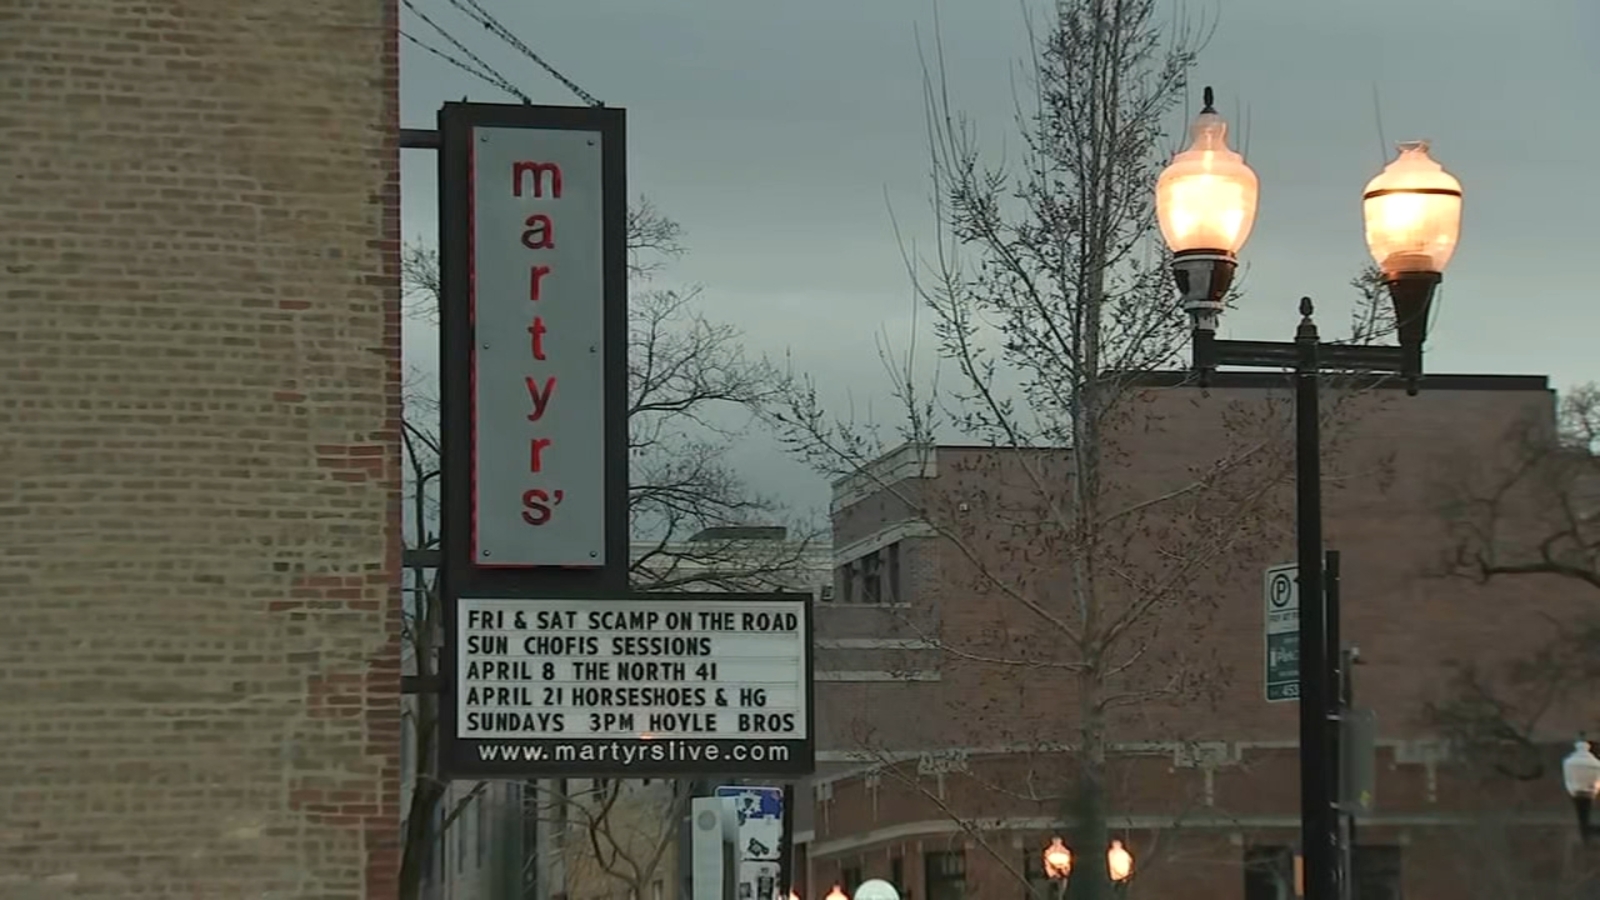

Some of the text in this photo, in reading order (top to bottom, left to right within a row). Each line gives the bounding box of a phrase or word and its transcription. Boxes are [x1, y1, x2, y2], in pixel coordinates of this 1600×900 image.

[468, 610, 797, 631] FRI & SAT SCAMP ON THE ROAD
[467, 636, 711, 656] SUN CHOFIS SESSIONS
[467, 662, 716, 681] APRIL 8 THE NORTH 41
[467, 687, 766, 706] APRIL 21 HORSESHOES & HG
[467, 713, 795, 732] SUNDAYS 3PM HOYLE BROS
[479, 742, 789, 764] www.martyrslive.com
